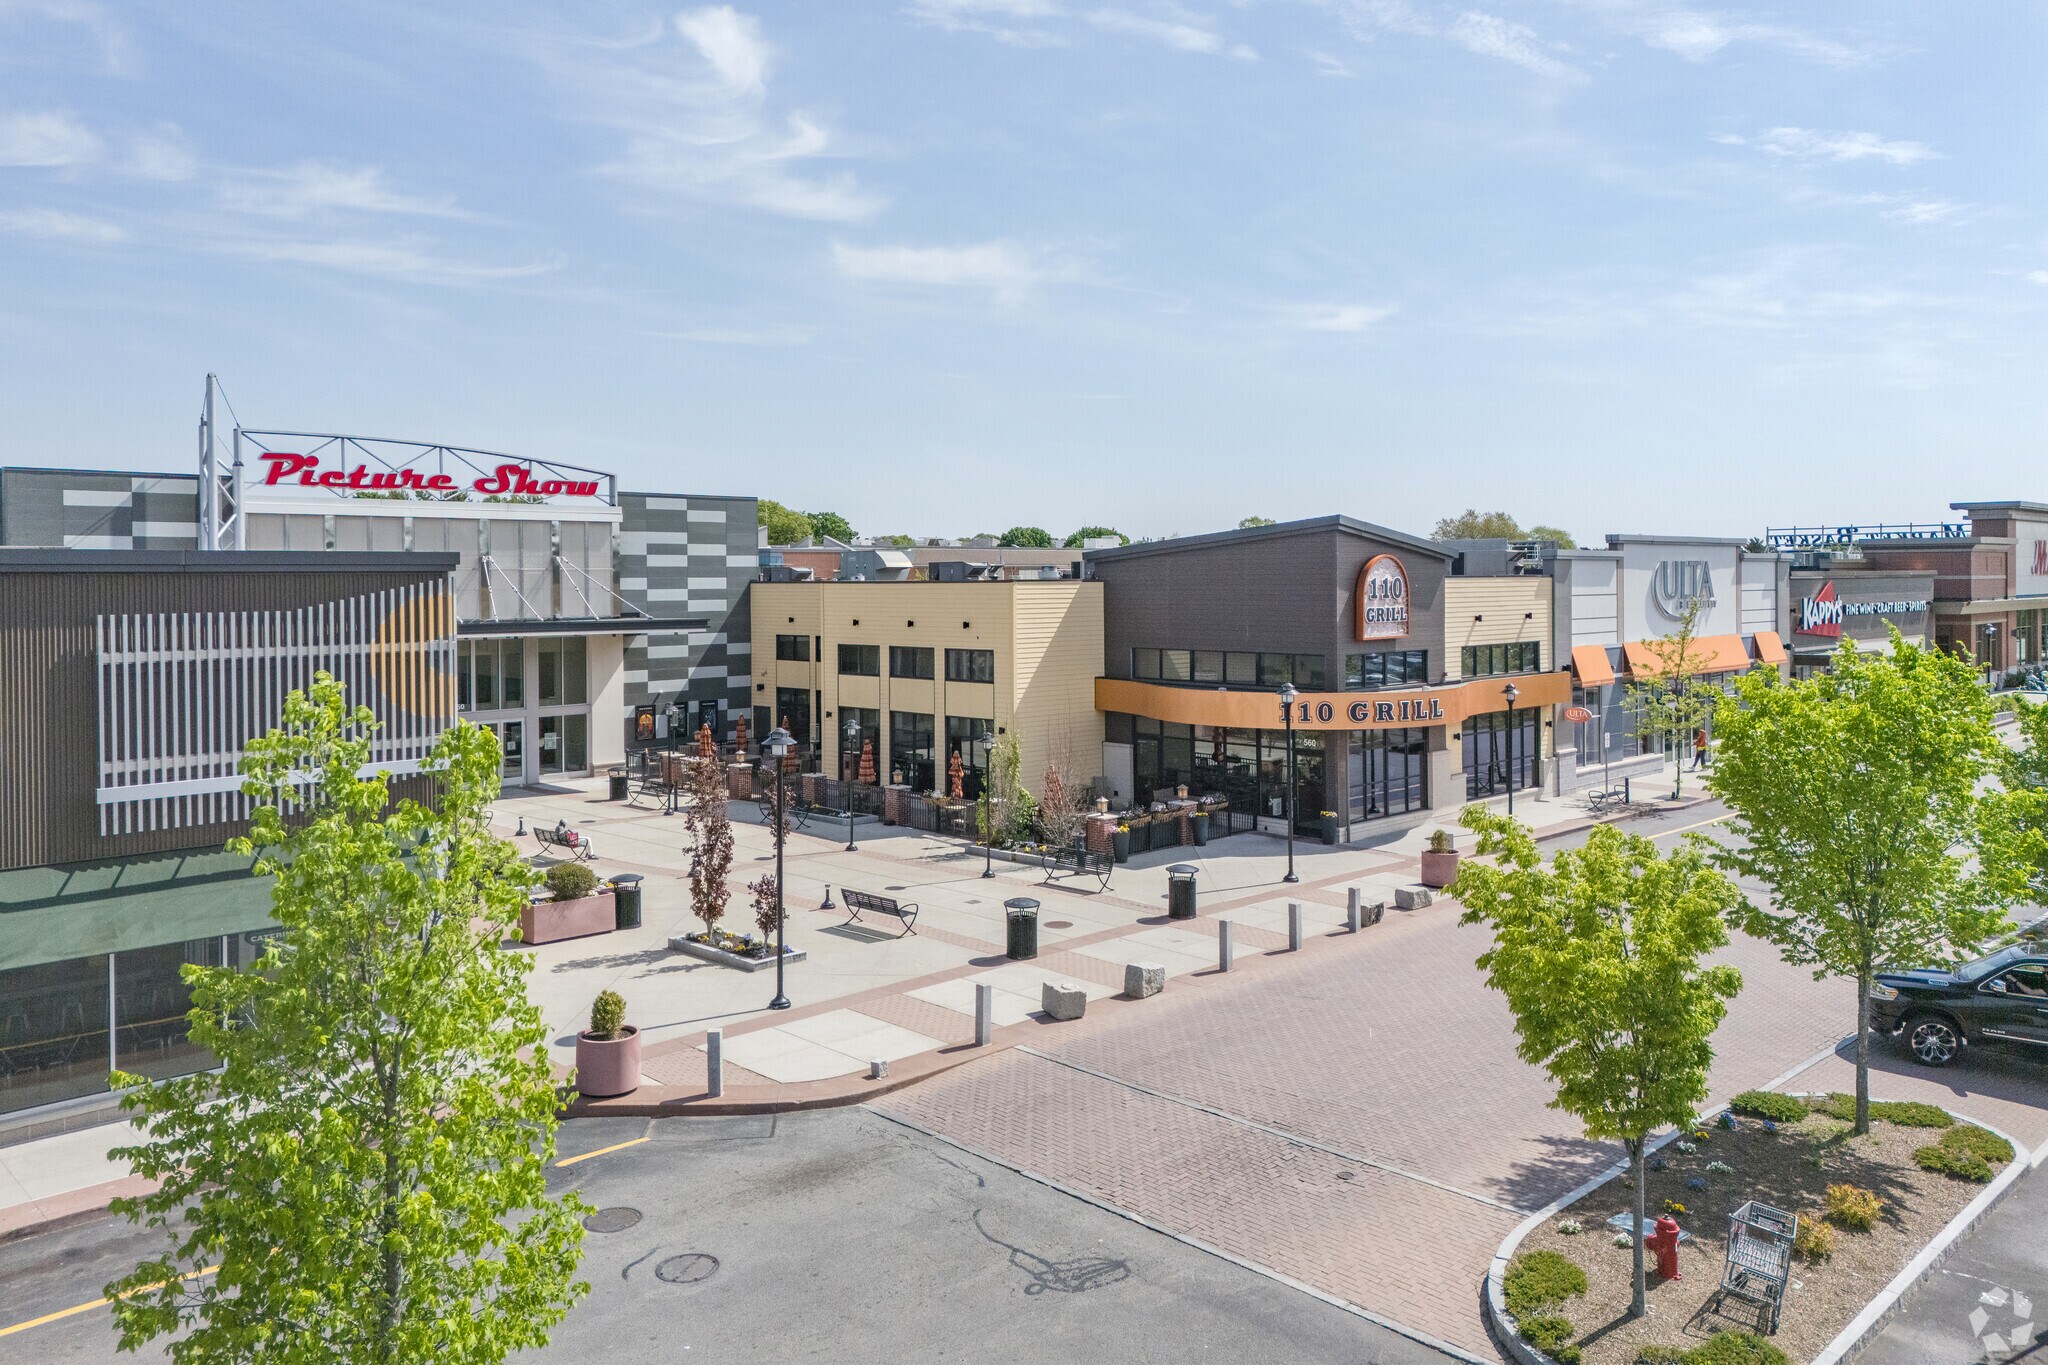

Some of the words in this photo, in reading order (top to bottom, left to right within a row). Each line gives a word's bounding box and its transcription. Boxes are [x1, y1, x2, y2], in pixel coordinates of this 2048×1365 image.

[259, 452, 459, 490] Picture
[473, 464, 599, 496] Show
[1370, 577, 1403, 600] 110
[1660, 561, 1714, 599] ULTA
[1366, 606, 1408, 623] GRILL
[1676, 600, 1717, 609] BEUTY
[1801, 595, 1843, 630] KAPPY'S
[1845, 603, 1860, 615] FINE
[1860, 602, 1874, 614] WINE
[1877, 601, 1894, 613] CRAFT
[1894, 601, 1907, 612] BEER
[1909, 600, 1927, 611] SPIRITS
[1280, 701, 1335, 724] 110
[1348, 698, 1444, 724] GRILL
[1568, 709, 1589, 718] ULTA
[1303, 738, 1316, 747] 560
